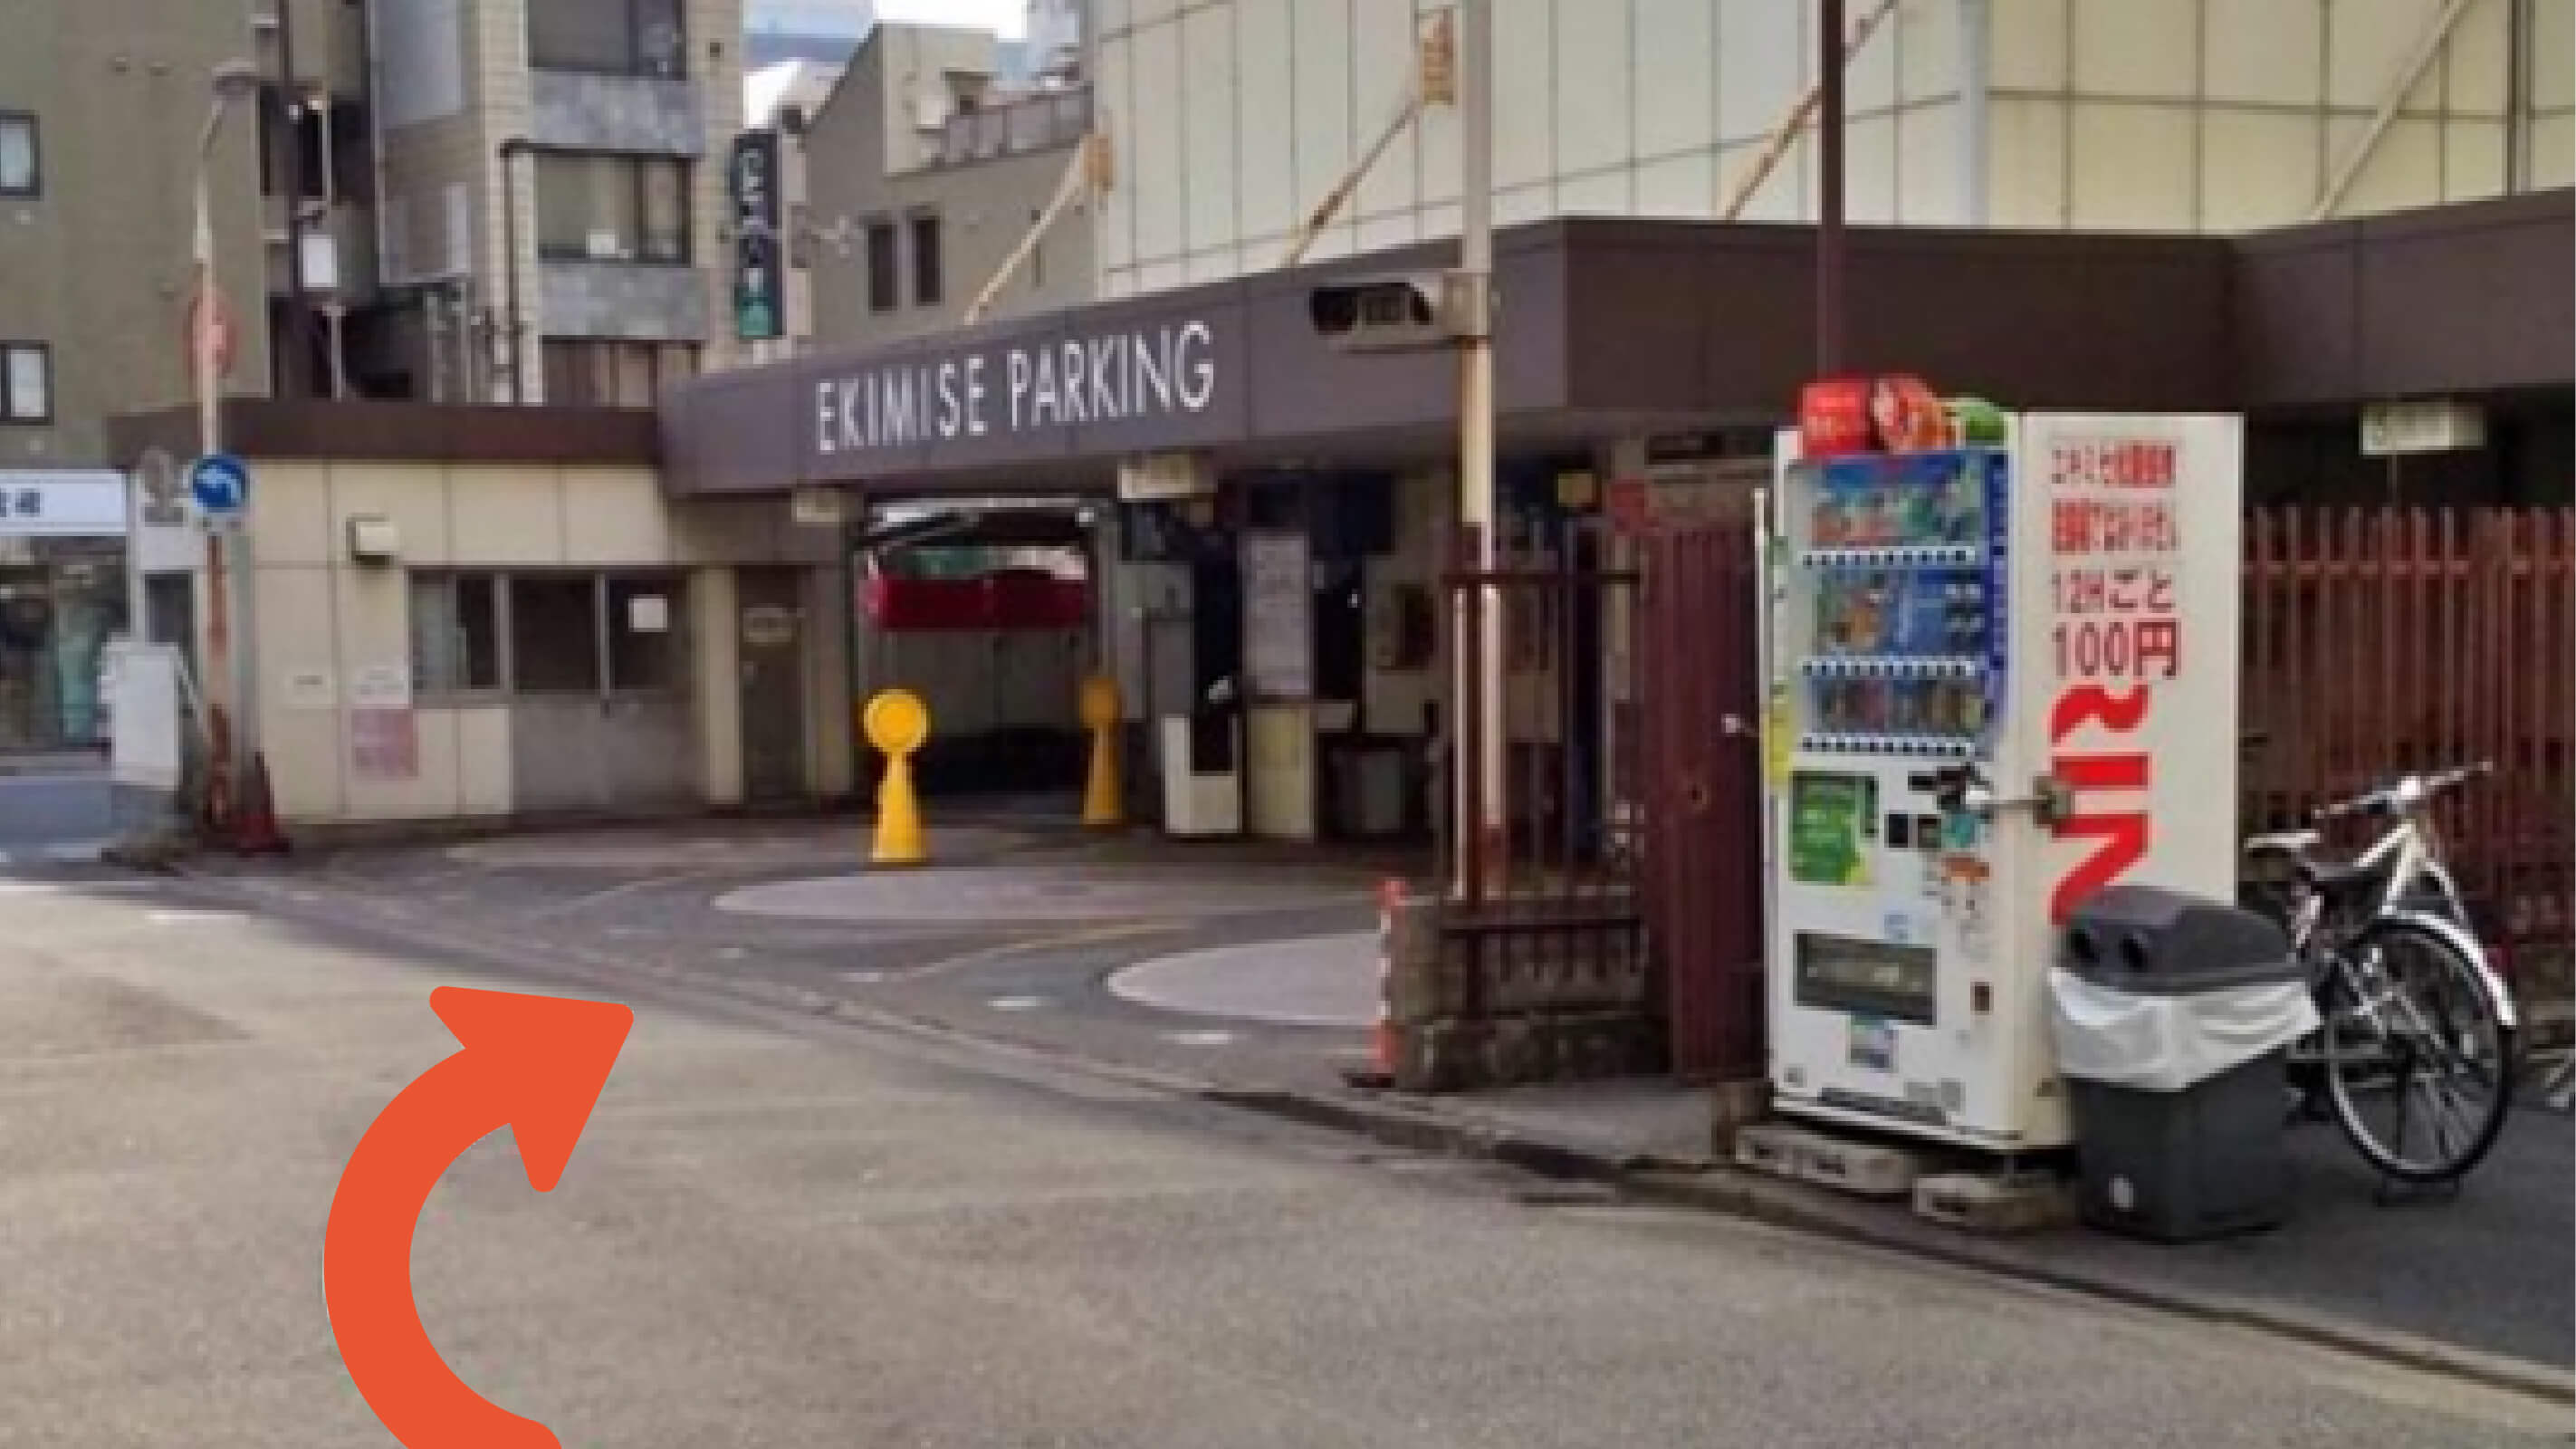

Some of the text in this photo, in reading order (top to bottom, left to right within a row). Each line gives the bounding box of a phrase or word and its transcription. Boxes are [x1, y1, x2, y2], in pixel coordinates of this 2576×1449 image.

[818, 321, 1214, 454] EKIMISE PARKING
[2051, 619, 2181, 679] 100円
